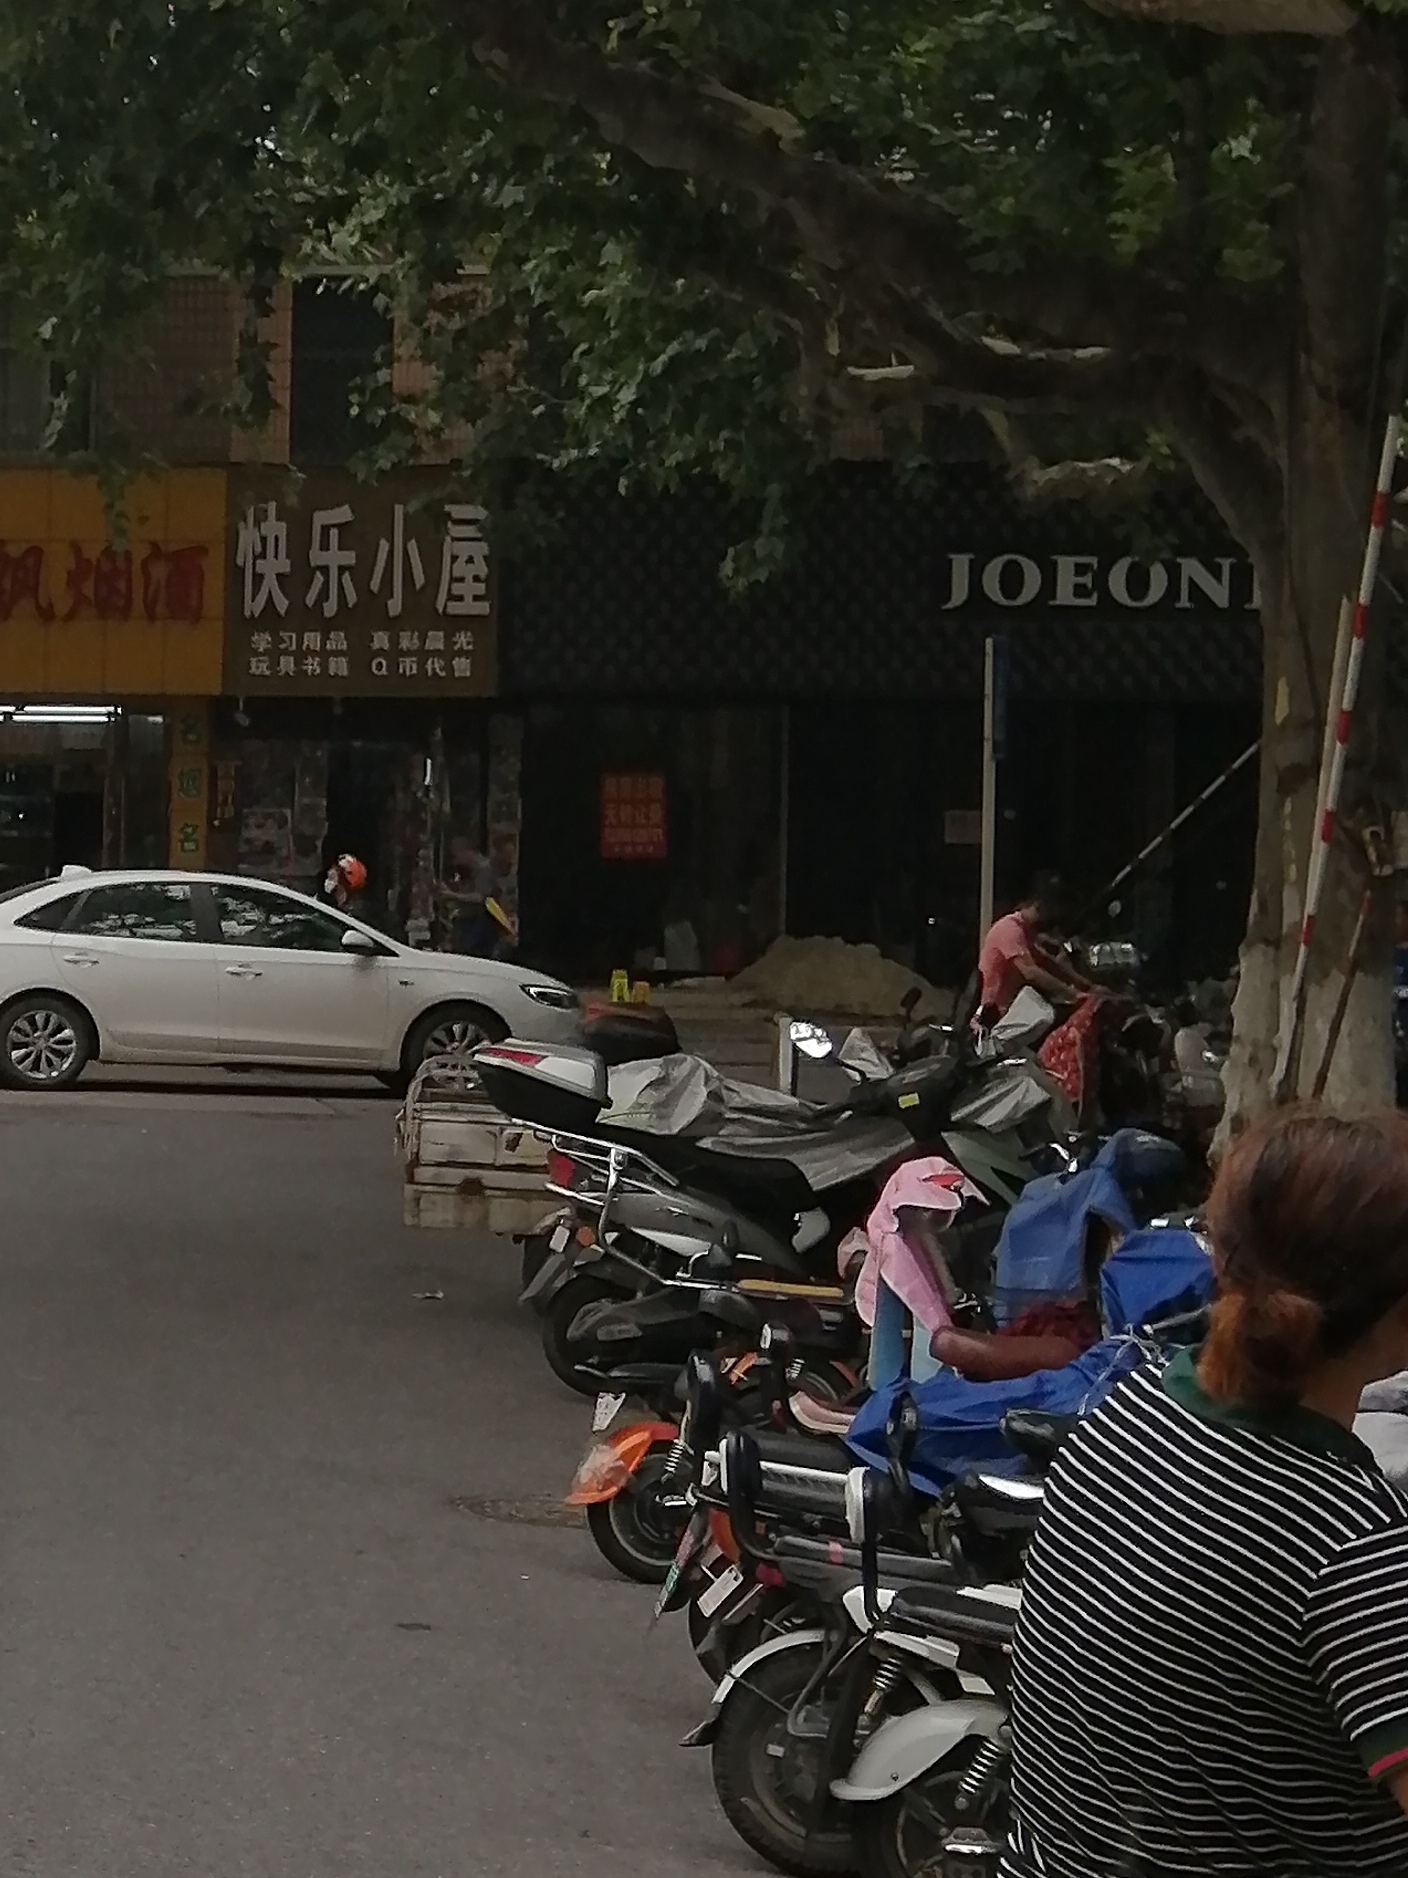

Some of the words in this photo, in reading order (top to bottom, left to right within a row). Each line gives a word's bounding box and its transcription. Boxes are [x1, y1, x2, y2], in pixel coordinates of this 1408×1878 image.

[234, 501, 491, 620] 快乐小屋
[942, 553, 1261, 611] JOEON
[250, 630, 348, 653] 学习用品
[248, 655, 349, 678] 玩具书籍
